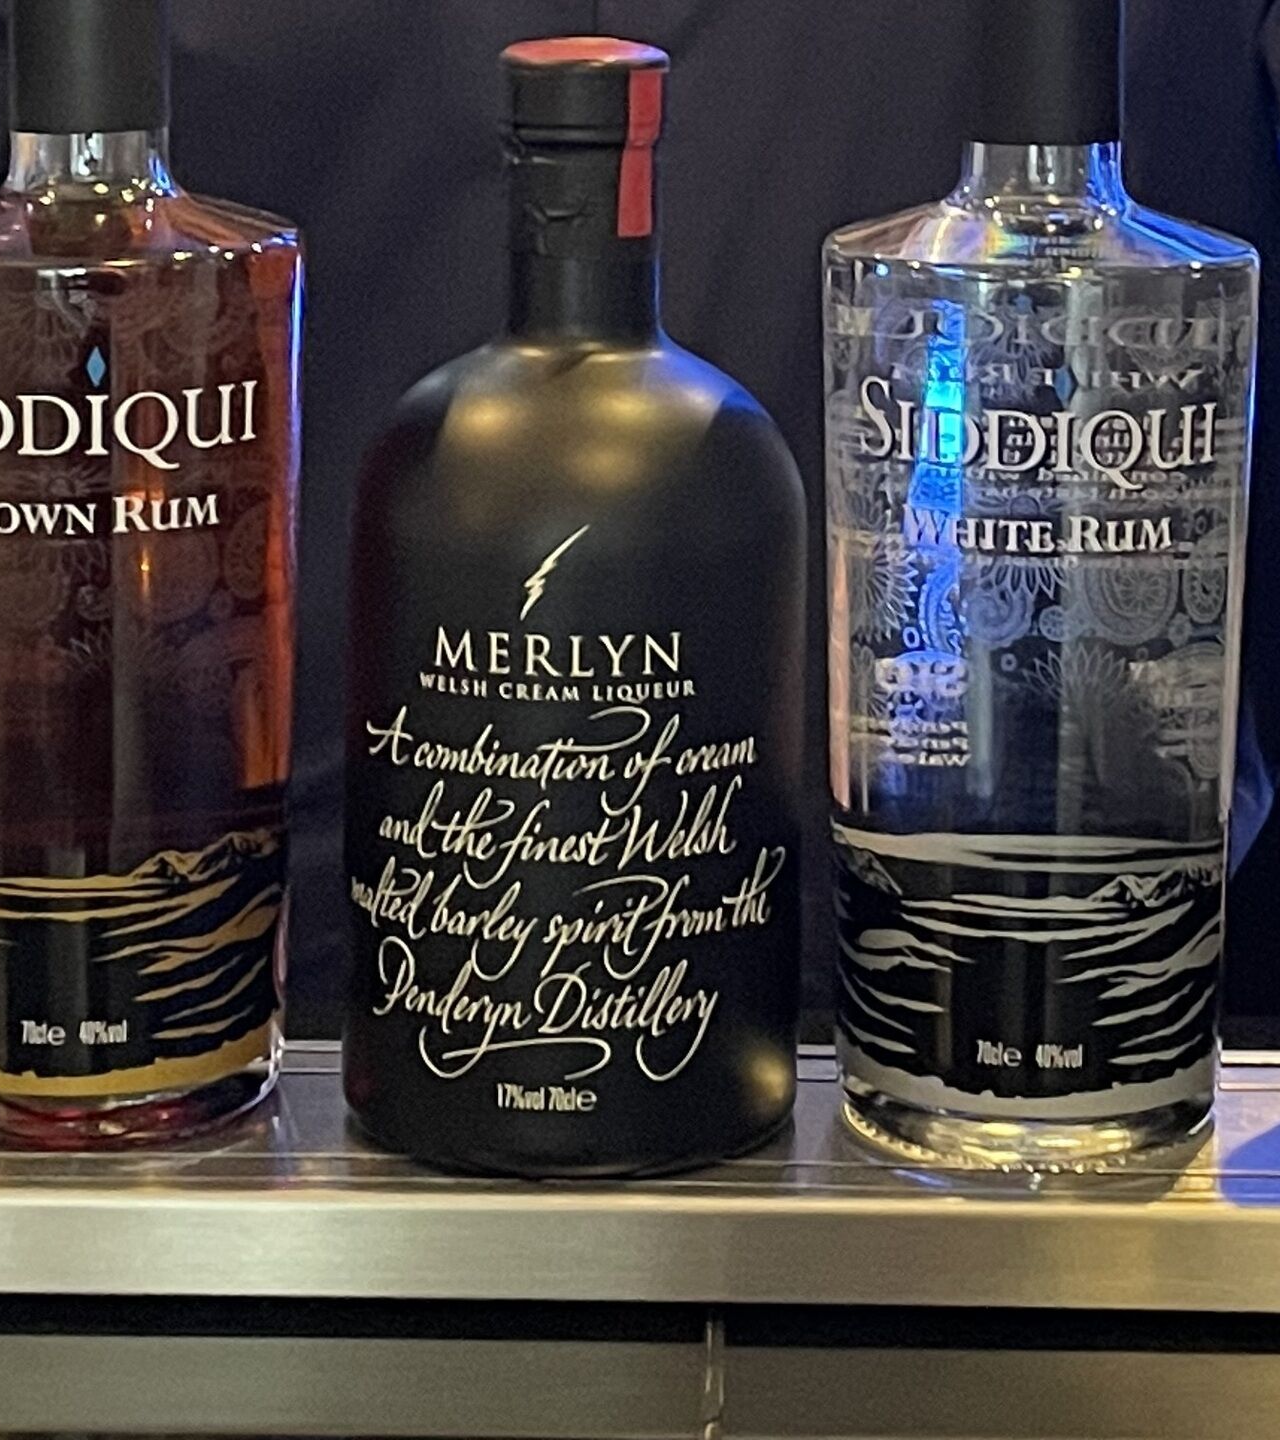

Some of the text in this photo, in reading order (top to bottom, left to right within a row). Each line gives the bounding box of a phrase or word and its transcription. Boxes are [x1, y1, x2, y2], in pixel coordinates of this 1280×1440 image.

[859, 375, 1218, 491] SIDDIQUI
[111, 493, 221, 534] RUM
[906, 512, 1175, 553] WHITE RUM
[420, 671, 696, 705] WELSH CREAM LIQUEUR
[433, 625, 683, 679] MERLYN
[366, 705, 758, 817] A combination of cream
[379, 775, 743, 890] and the finest Welsh
[431, 873, 542, 981] barley
[540, 875, 670, 979] spirit
[605, 874, 725, 981] from
[722, 847, 787, 927] the
[373, 936, 719, 1081] Penderyn Distillery
